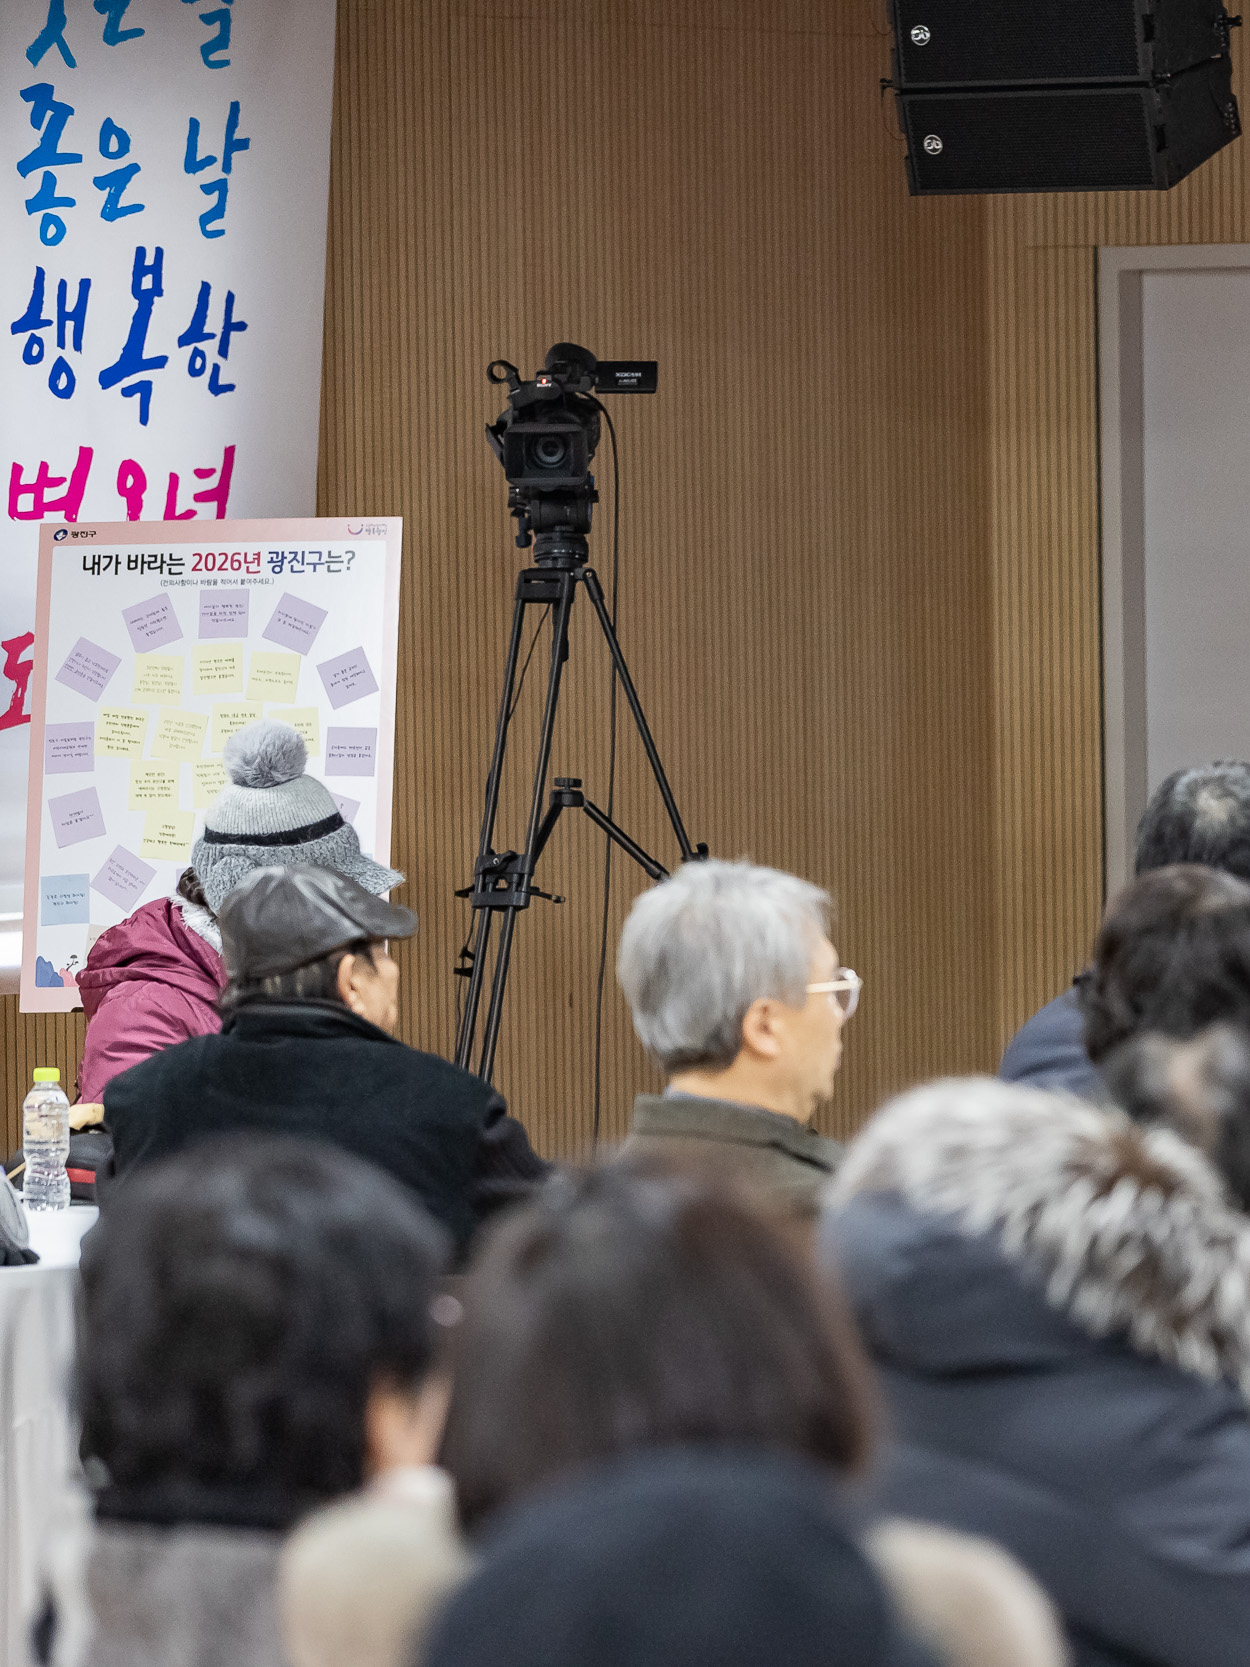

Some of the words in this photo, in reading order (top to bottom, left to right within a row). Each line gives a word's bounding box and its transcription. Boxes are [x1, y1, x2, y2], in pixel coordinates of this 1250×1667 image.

[17, 83, 145, 246] 좋은
[184, 100, 250, 239] 날
[10, 246, 250, 426] 행복한
[70, 531, 97, 539] 광진구
[82, 554, 121, 576] 내가
[127, 553, 185, 576] 바라는
[191, 550, 261, 575] 2026년
[267, 549, 356, 575] 광진구는?
